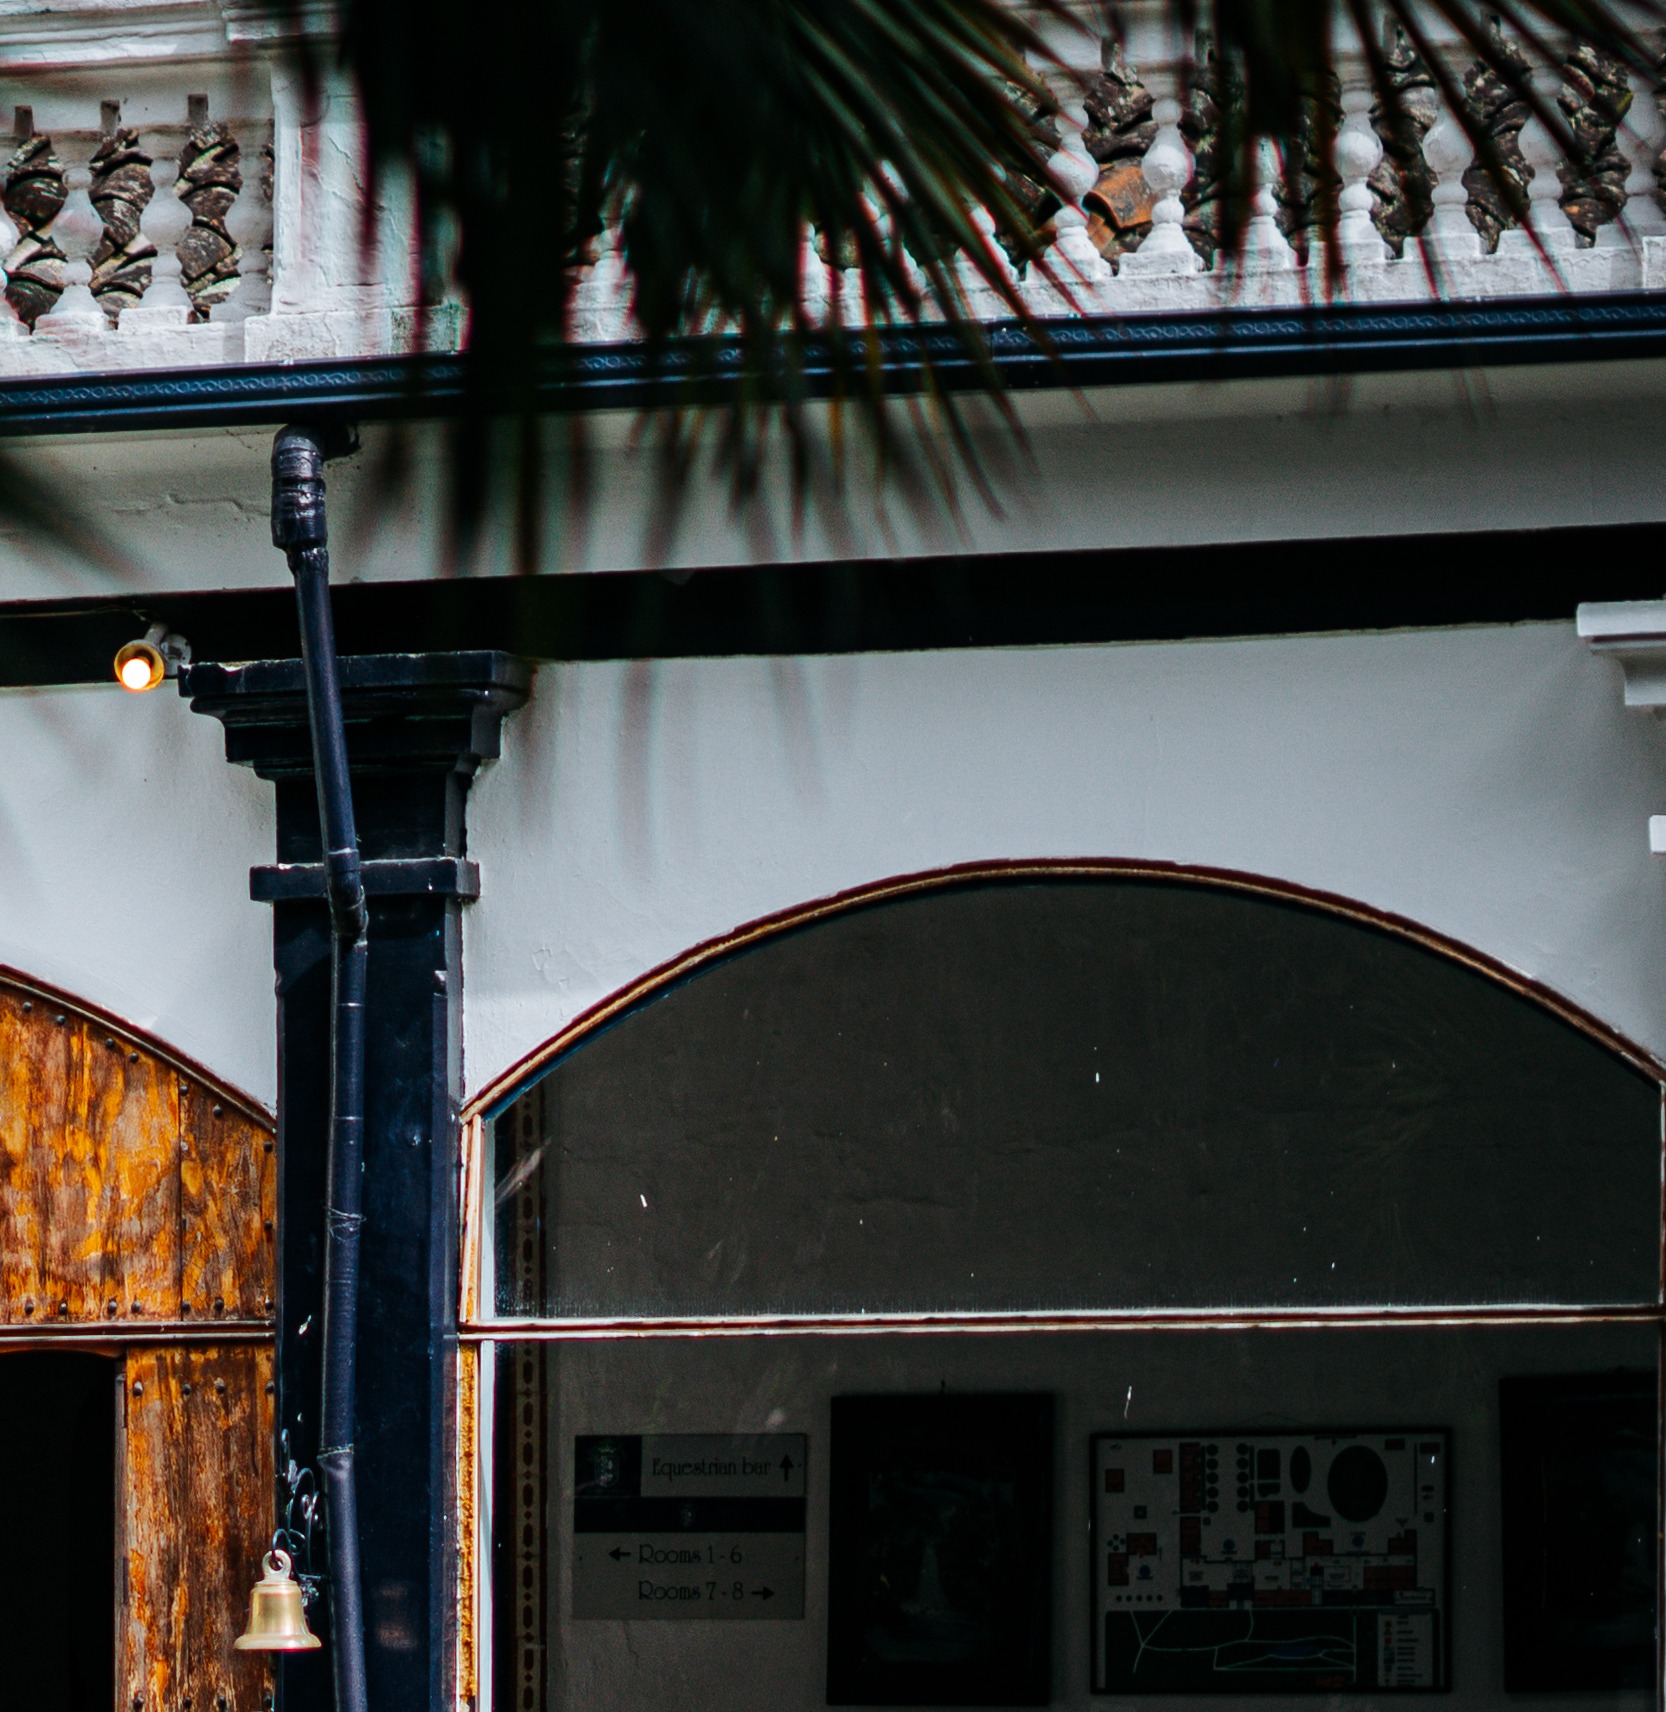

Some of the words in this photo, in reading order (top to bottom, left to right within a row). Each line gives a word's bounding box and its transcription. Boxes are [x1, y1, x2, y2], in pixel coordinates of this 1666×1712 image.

[652, 1457, 737, 1482] Equestrian
[742, 1456, 771, 1476] bar
[638, 1543, 701, 1564] Rooms
[730, 1544, 743, 1564] 6
[638, 1580, 701, 1601] Rooms
[706, 1581, 717, 1601] 7
[732, 1581, 744, 1601] 8
